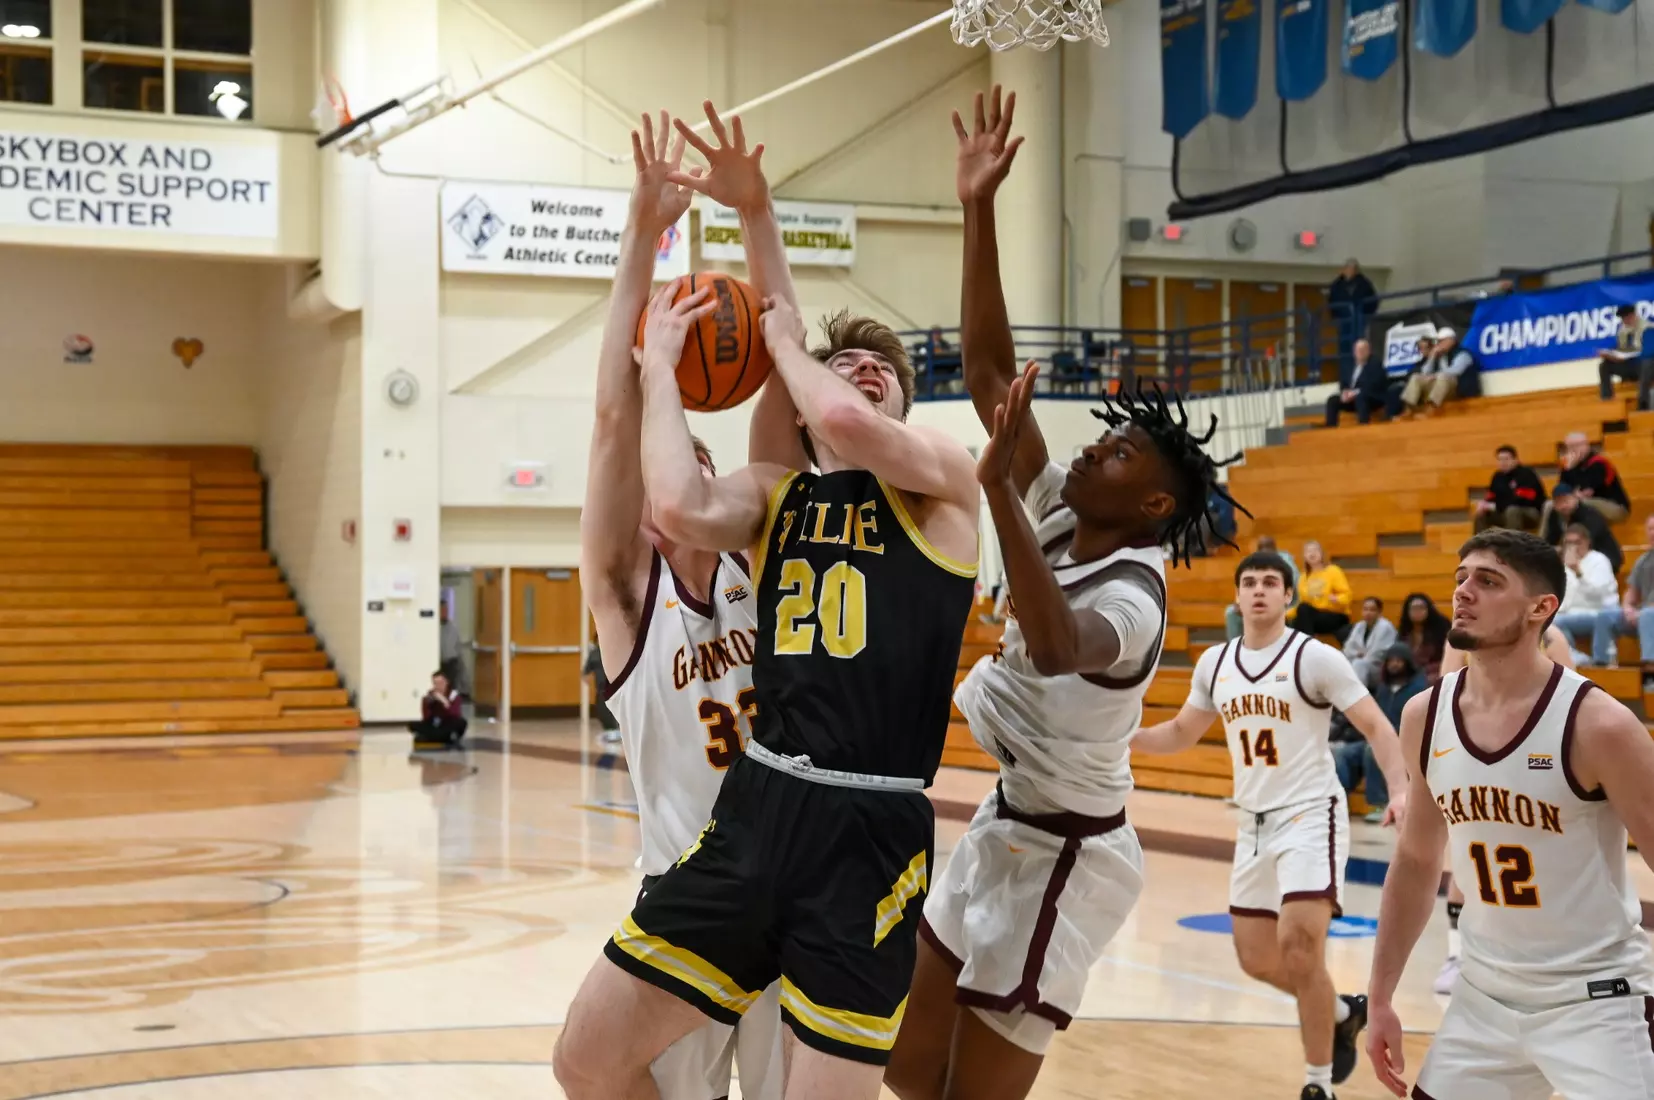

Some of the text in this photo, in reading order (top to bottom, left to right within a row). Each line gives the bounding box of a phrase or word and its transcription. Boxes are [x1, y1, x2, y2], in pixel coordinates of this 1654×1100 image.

[138, 147, 212, 172] AND
[117, 173, 271, 202] SUPPORT
[28, 197, 172, 227] CENTER
[531, 200, 604, 217] Welcome
[510, 224, 526, 236] to
[533, 226, 559, 240] the
[504, 247, 567, 263] Athletic
[725, 586, 747, 600] PSAC
[774, 558, 867, 659] 20
[672, 628, 758, 691] GANNO
[1221, 694, 1291, 723] GANNON
[1240, 728, 1278, 767] 14
[1528, 757, 1553, 766] PSAC
[1469, 841, 1541, 908] 12
[1617, 983, 1624, 991] M
